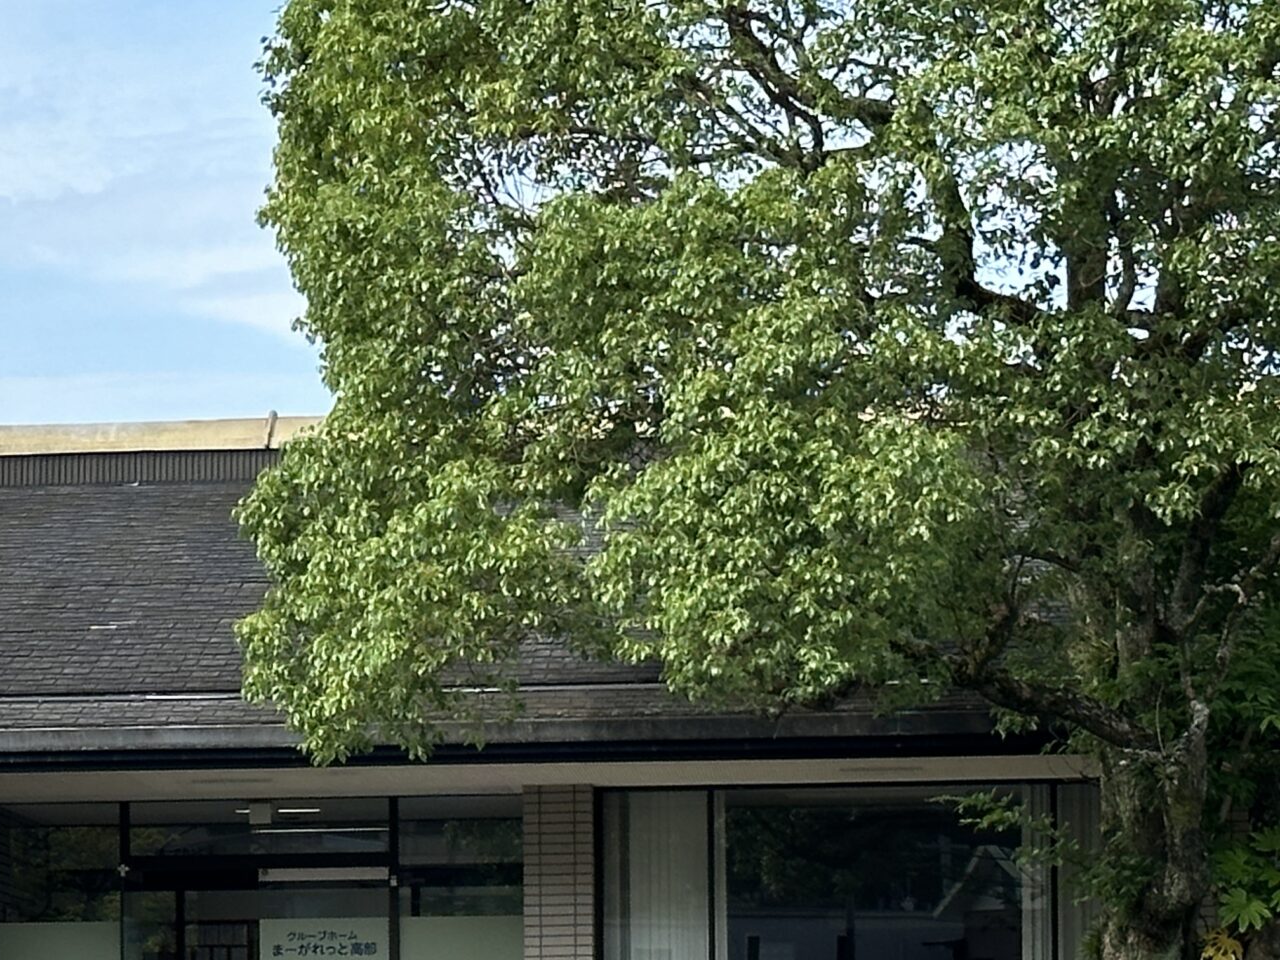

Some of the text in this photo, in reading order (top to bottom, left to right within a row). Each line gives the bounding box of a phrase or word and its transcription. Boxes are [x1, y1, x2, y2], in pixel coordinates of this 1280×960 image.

[286, 930, 358, 942] グループホーム
